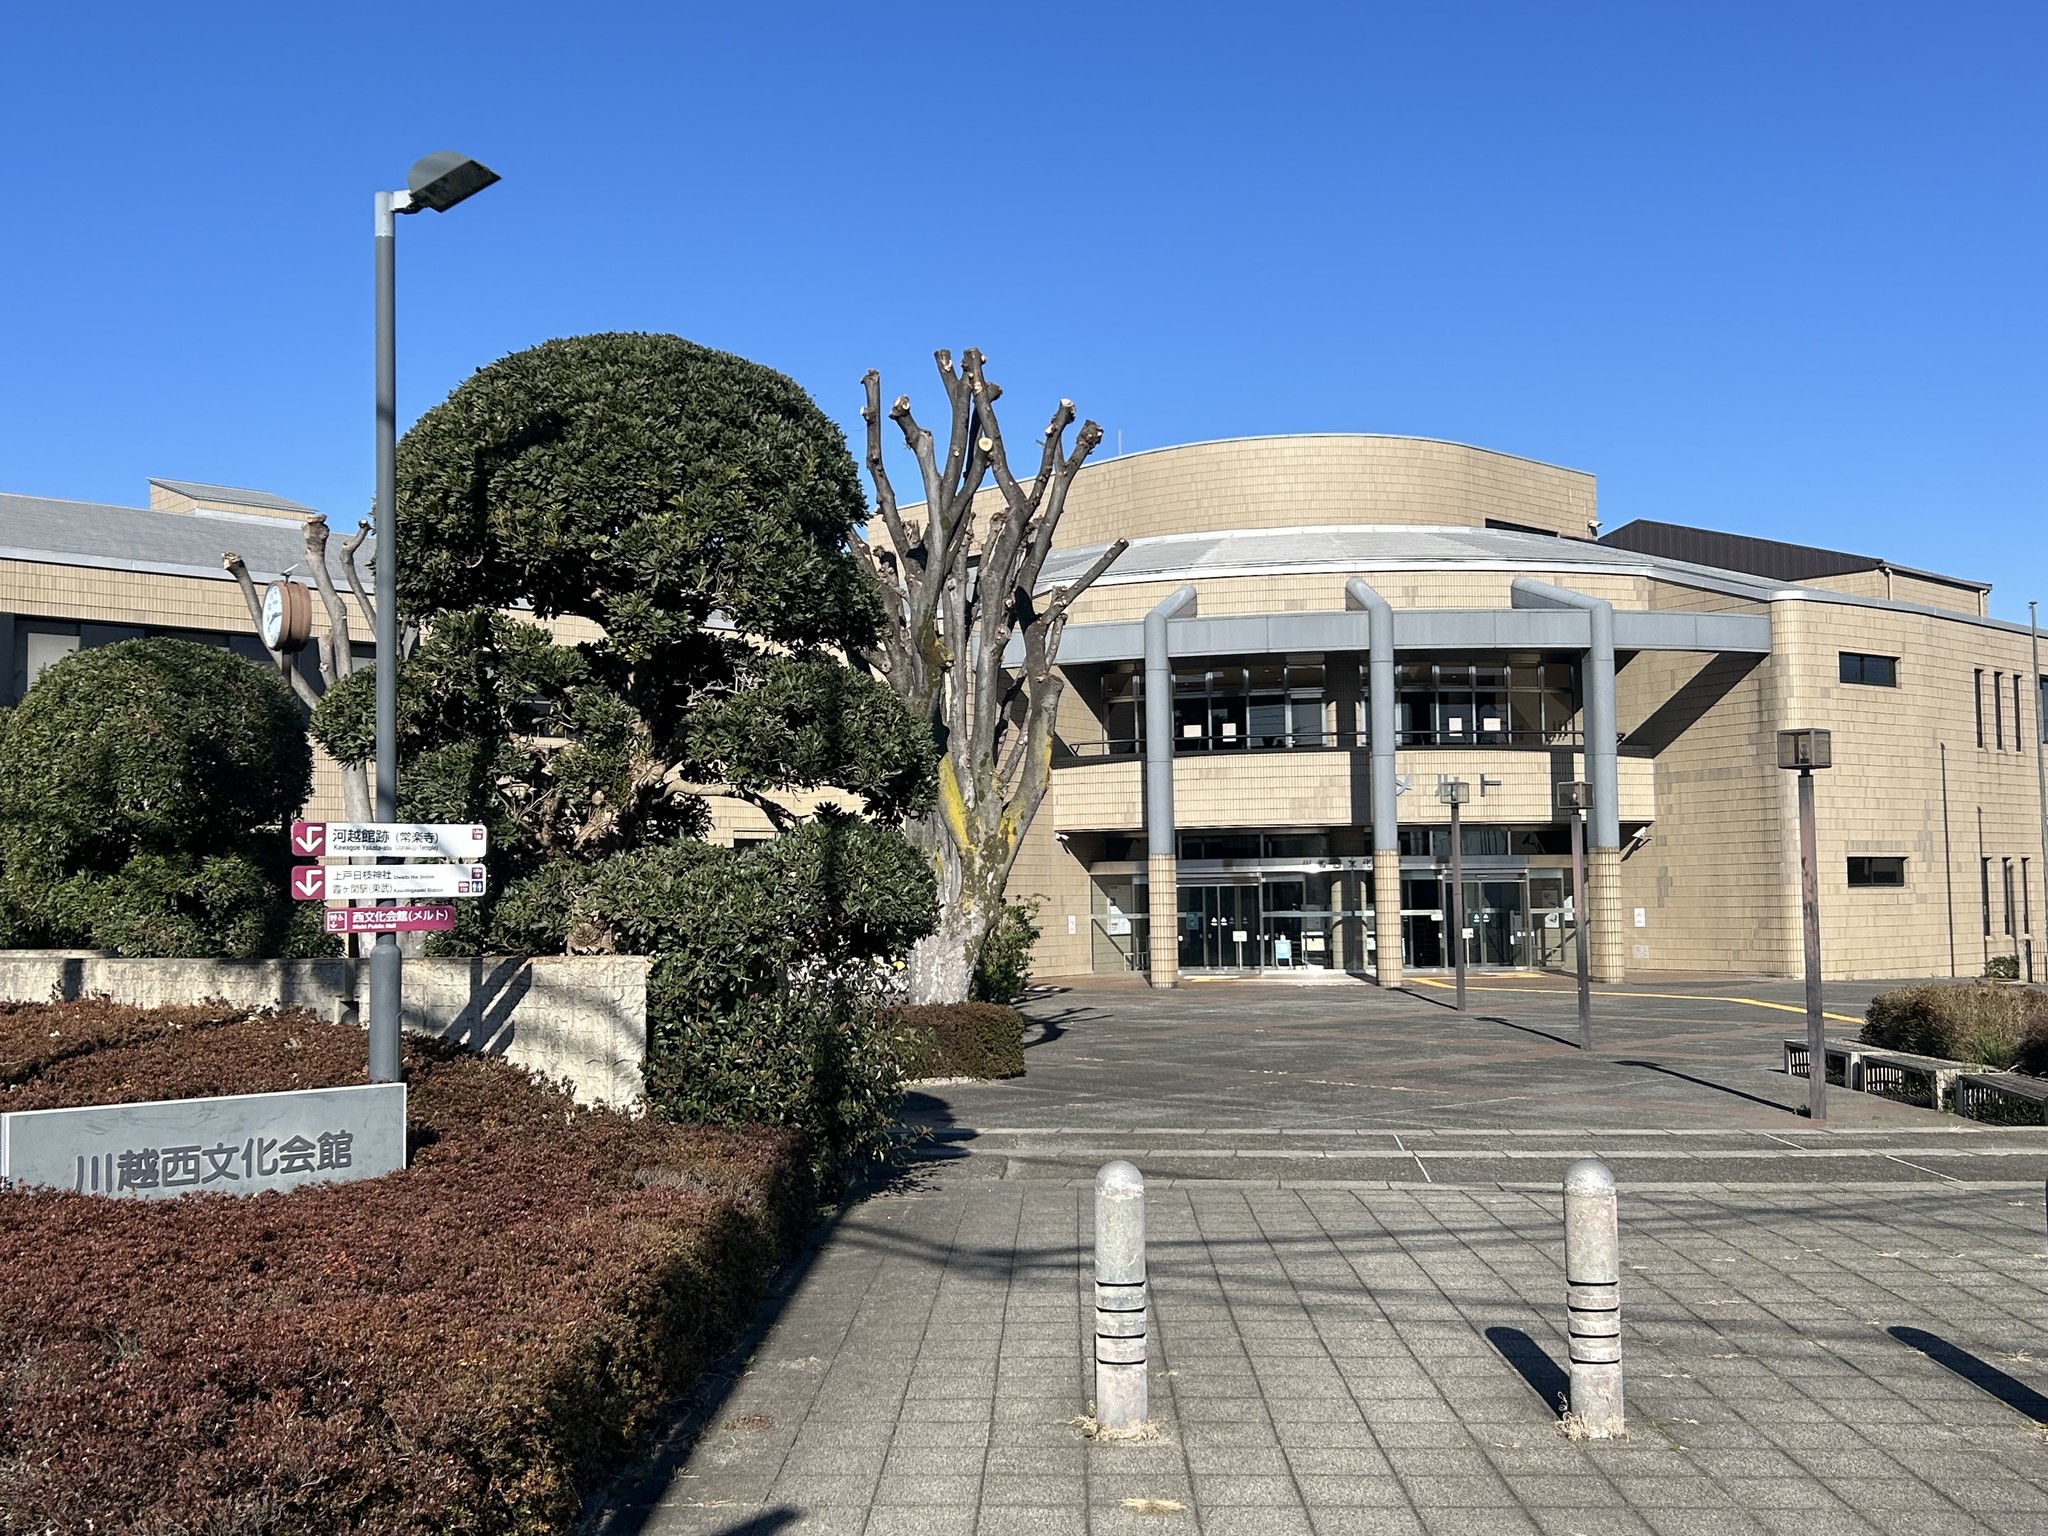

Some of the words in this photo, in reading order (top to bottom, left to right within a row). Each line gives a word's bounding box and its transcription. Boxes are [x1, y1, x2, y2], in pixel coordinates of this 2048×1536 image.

[332, 870, 392, 880] 上戸日枝神社
[352, 910, 448, 923] 西文化会館(メルト)
[75, 1129, 353, 1193] 川越西文化会館
